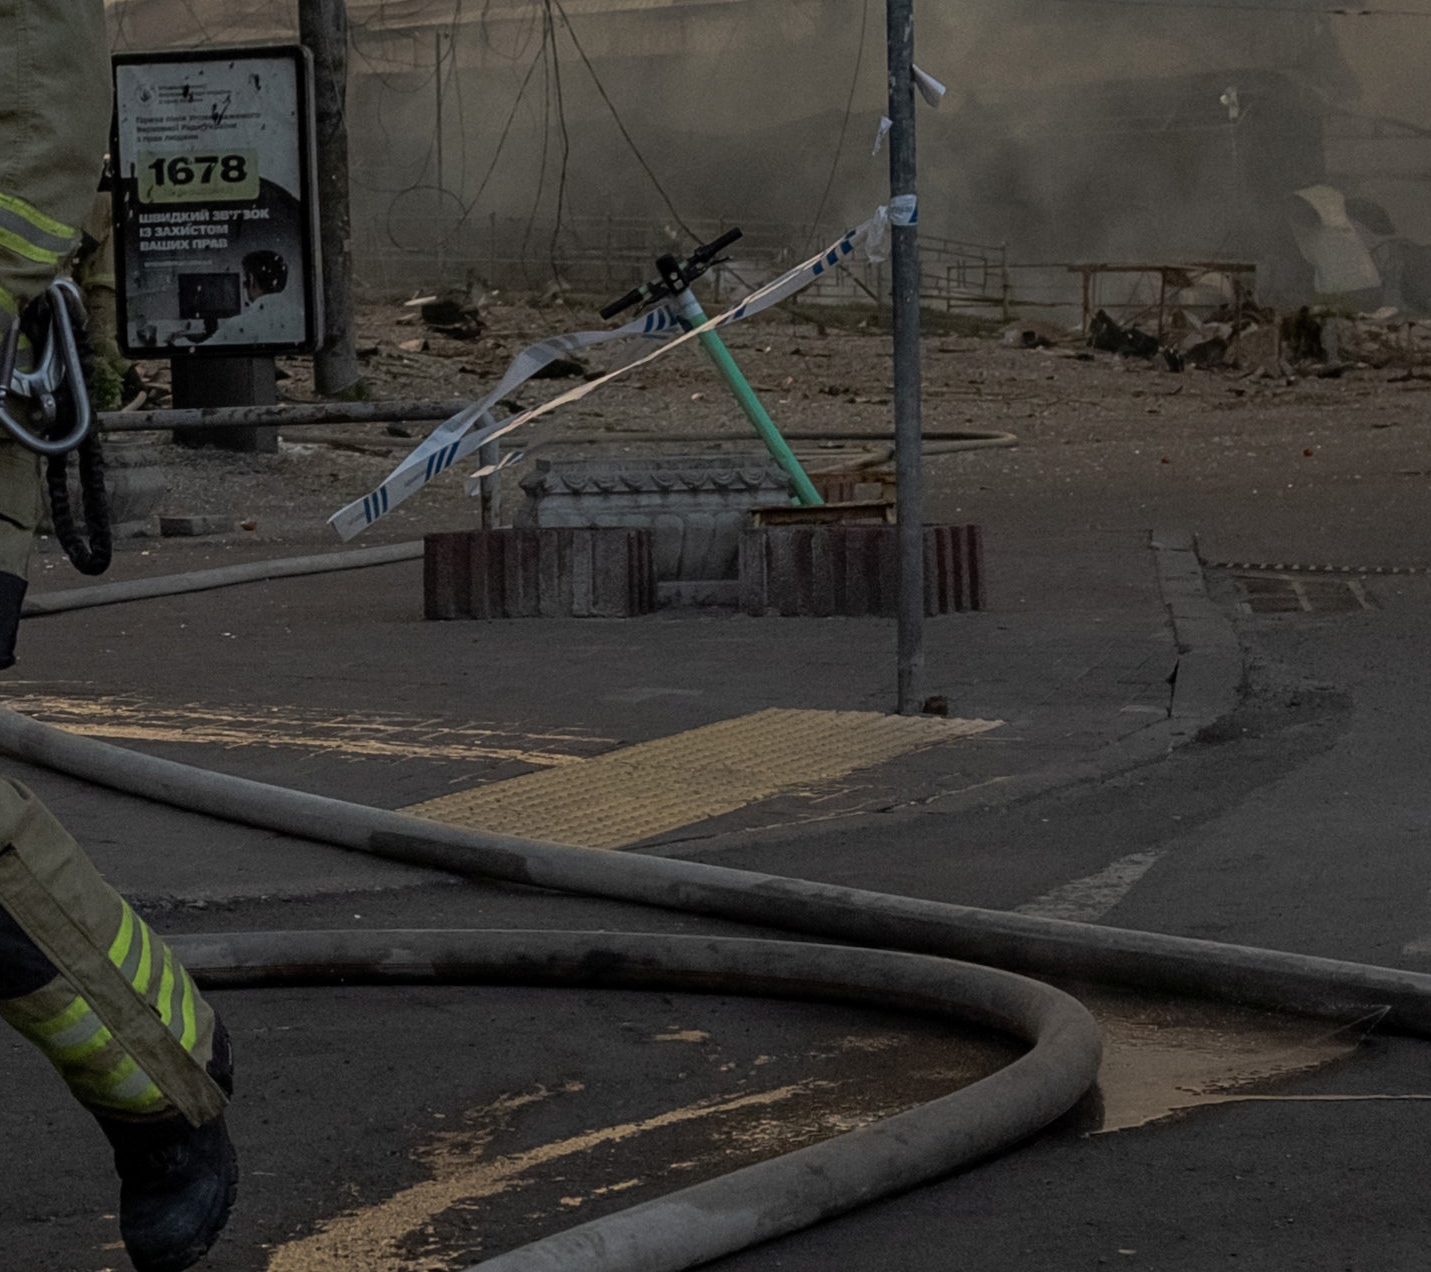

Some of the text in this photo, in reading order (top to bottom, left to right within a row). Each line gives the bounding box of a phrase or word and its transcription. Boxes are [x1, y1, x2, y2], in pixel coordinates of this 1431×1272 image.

[148, 154, 246, 187] 1678
[139, 209, 210, 224] ШВИДКИЙ
[139, 224, 228, 238] ІЗ ЗАХИСТОМ
[140, 238, 228, 252] ВАШИХ ПРАВ
